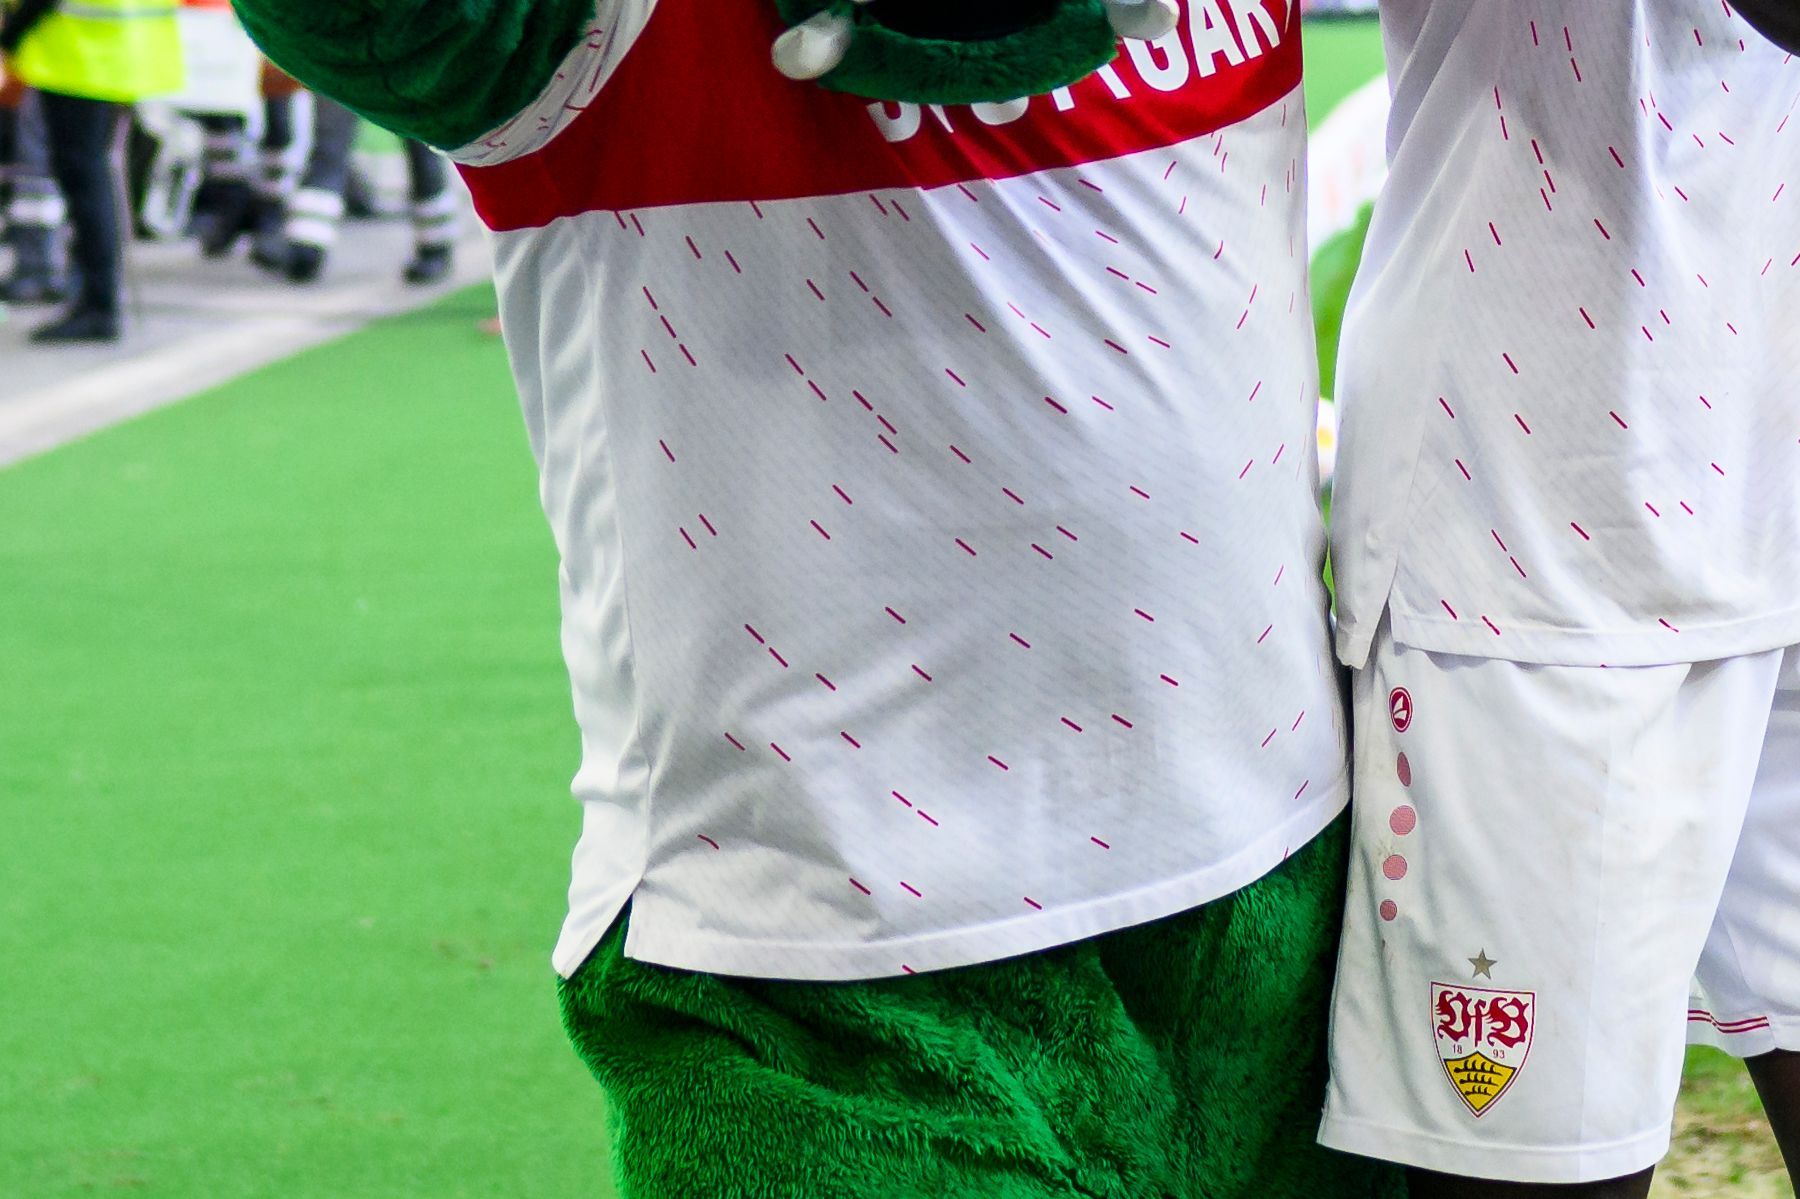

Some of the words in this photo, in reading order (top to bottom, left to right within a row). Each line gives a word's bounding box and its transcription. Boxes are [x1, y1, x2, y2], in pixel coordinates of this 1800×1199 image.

[1435, 990, 1530, 1049] VfB
[1452, 1044, 1463, 1055] 18
[1492, 1048, 1506, 1059] 93
